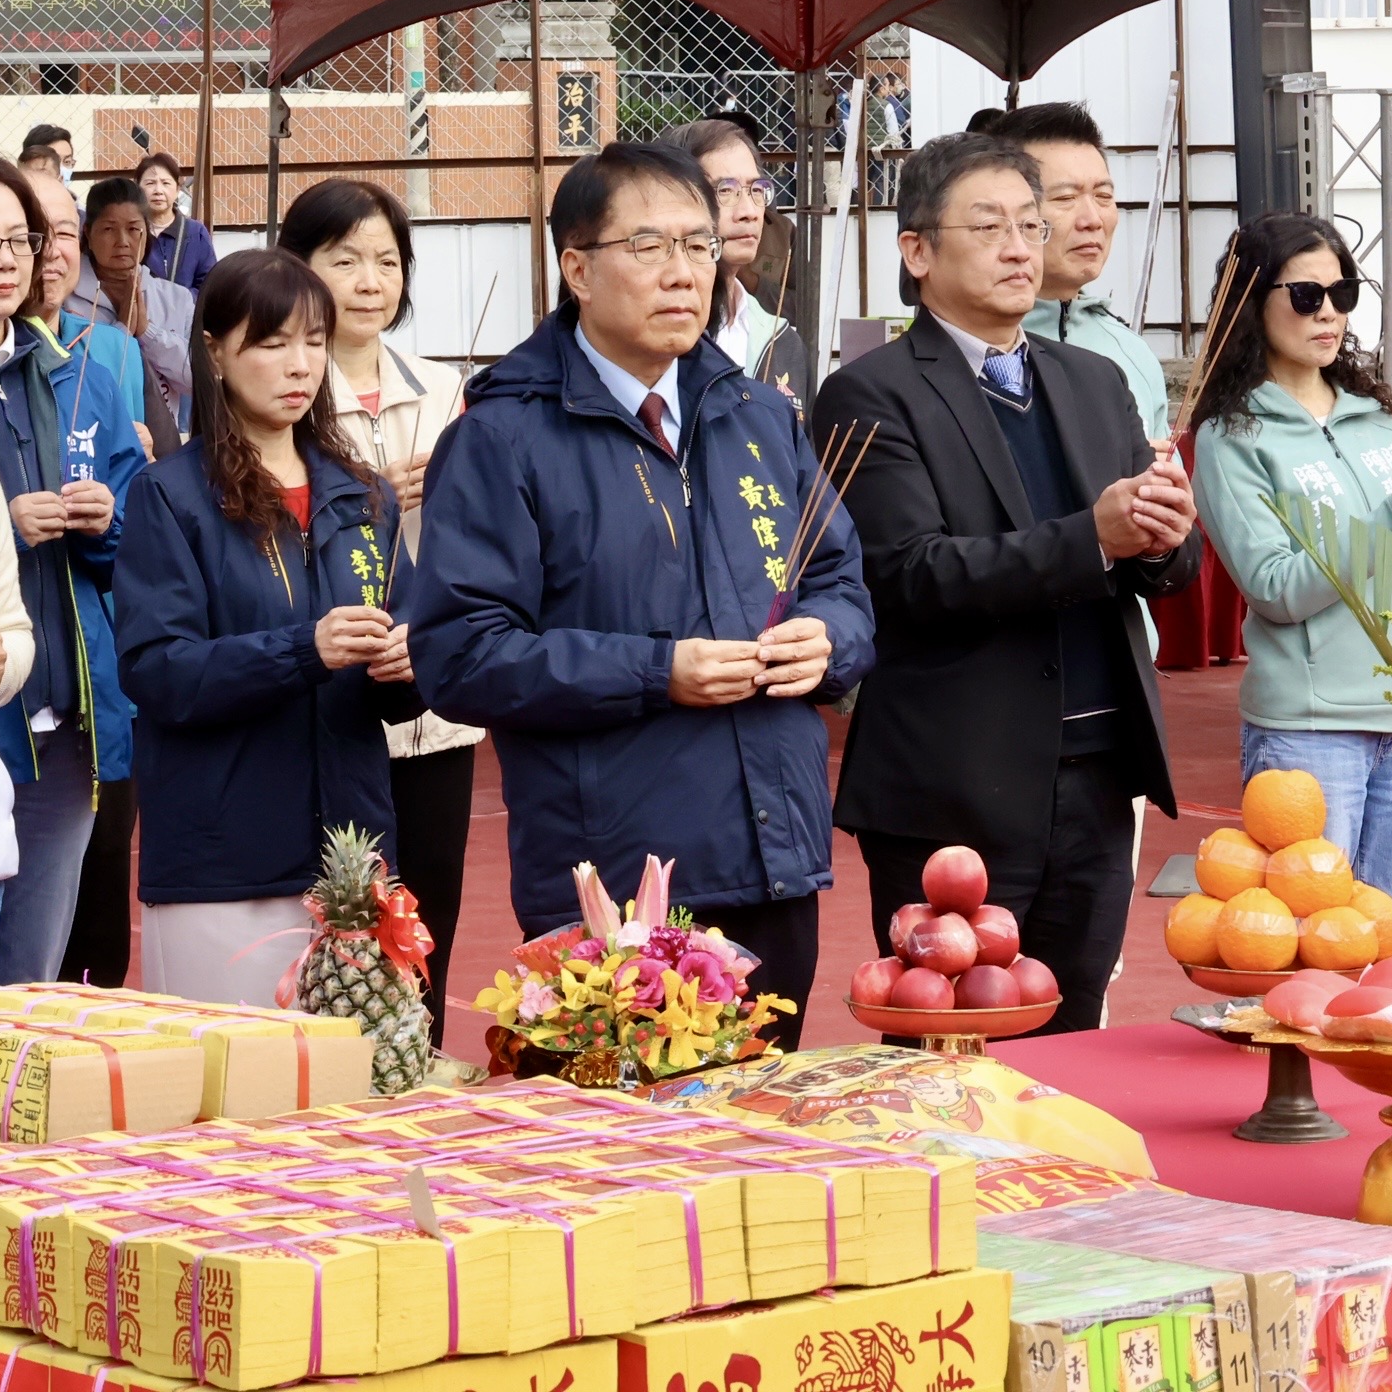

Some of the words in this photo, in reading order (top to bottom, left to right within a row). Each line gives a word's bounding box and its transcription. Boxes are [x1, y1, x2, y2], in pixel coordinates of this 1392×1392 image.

[563, 81, 586, 144] 治平
[634, 463, 656, 505] CHAMOIS
[1266, 1321, 1291, 1352] 11
[1027, 1338, 1056, 1373] 10
[1229, 1350, 1249, 1387] 11
